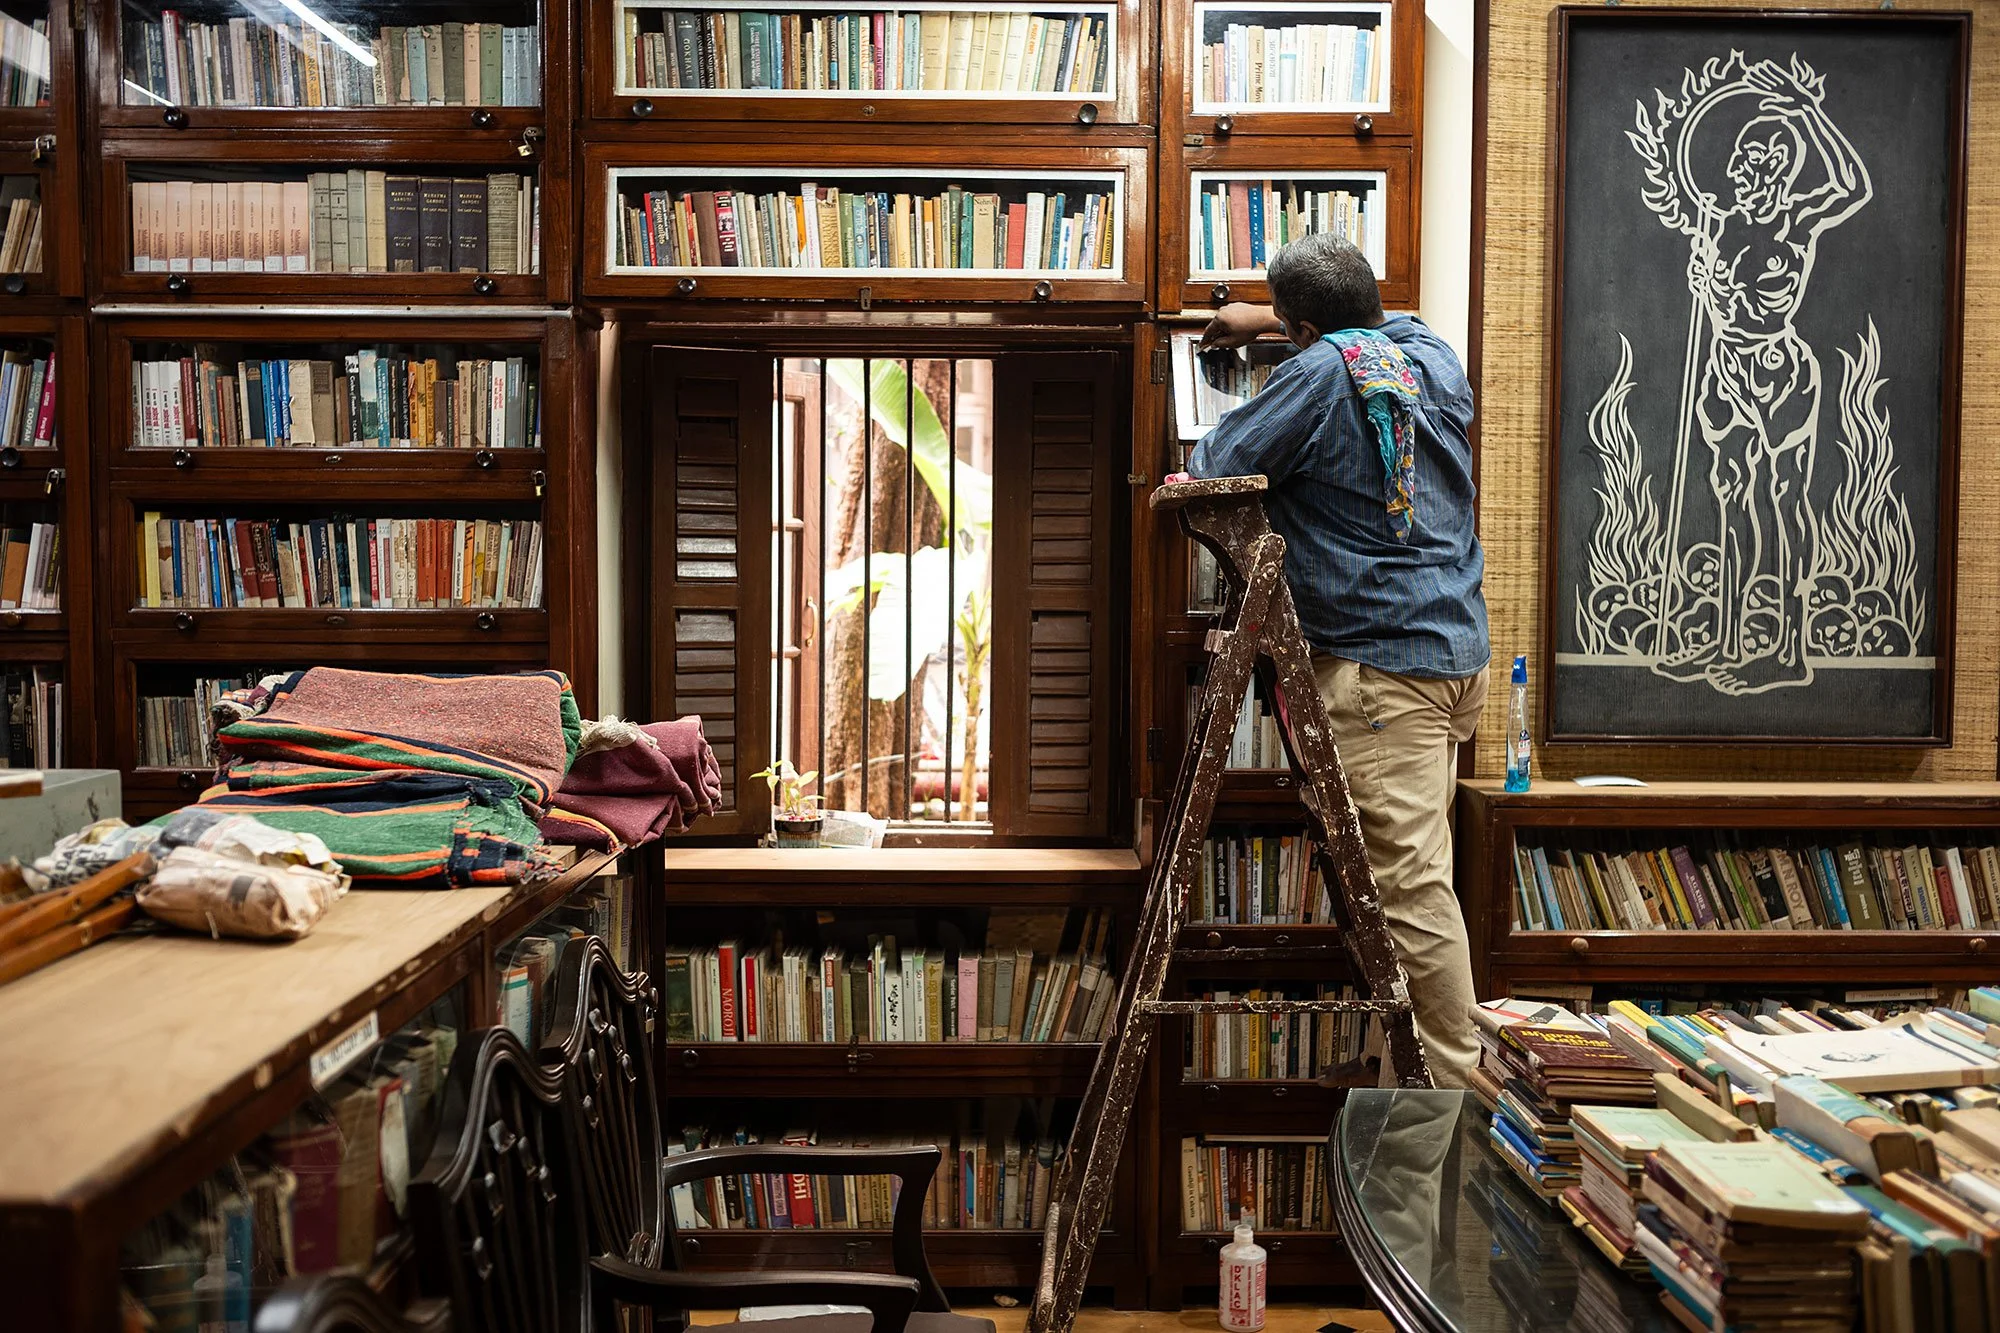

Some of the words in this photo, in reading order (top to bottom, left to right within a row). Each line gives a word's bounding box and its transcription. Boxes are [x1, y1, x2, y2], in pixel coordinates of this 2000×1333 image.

[683, 39, 693, 80] GOKHALE
[861, 27, 869, 69] KAMARAJ
[821, 215, 833, 266] HAPPINESS
[833, 255, 840, 265] OF
[34, 371, 43, 402] FREEDOM
[24, 407, 34, 441] TOOFAN
[1987, 857, 1996, 882] AMBEDKAR
[1690, 876, 1699, 890] B.G.
[1695, 891, 1706, 910] KHER
[1787, 882, 1804, 910] ROY
[722, 988, 734, 1036] NAOROJI
[1186, 1166, 1195, 1188] Gandhiji
